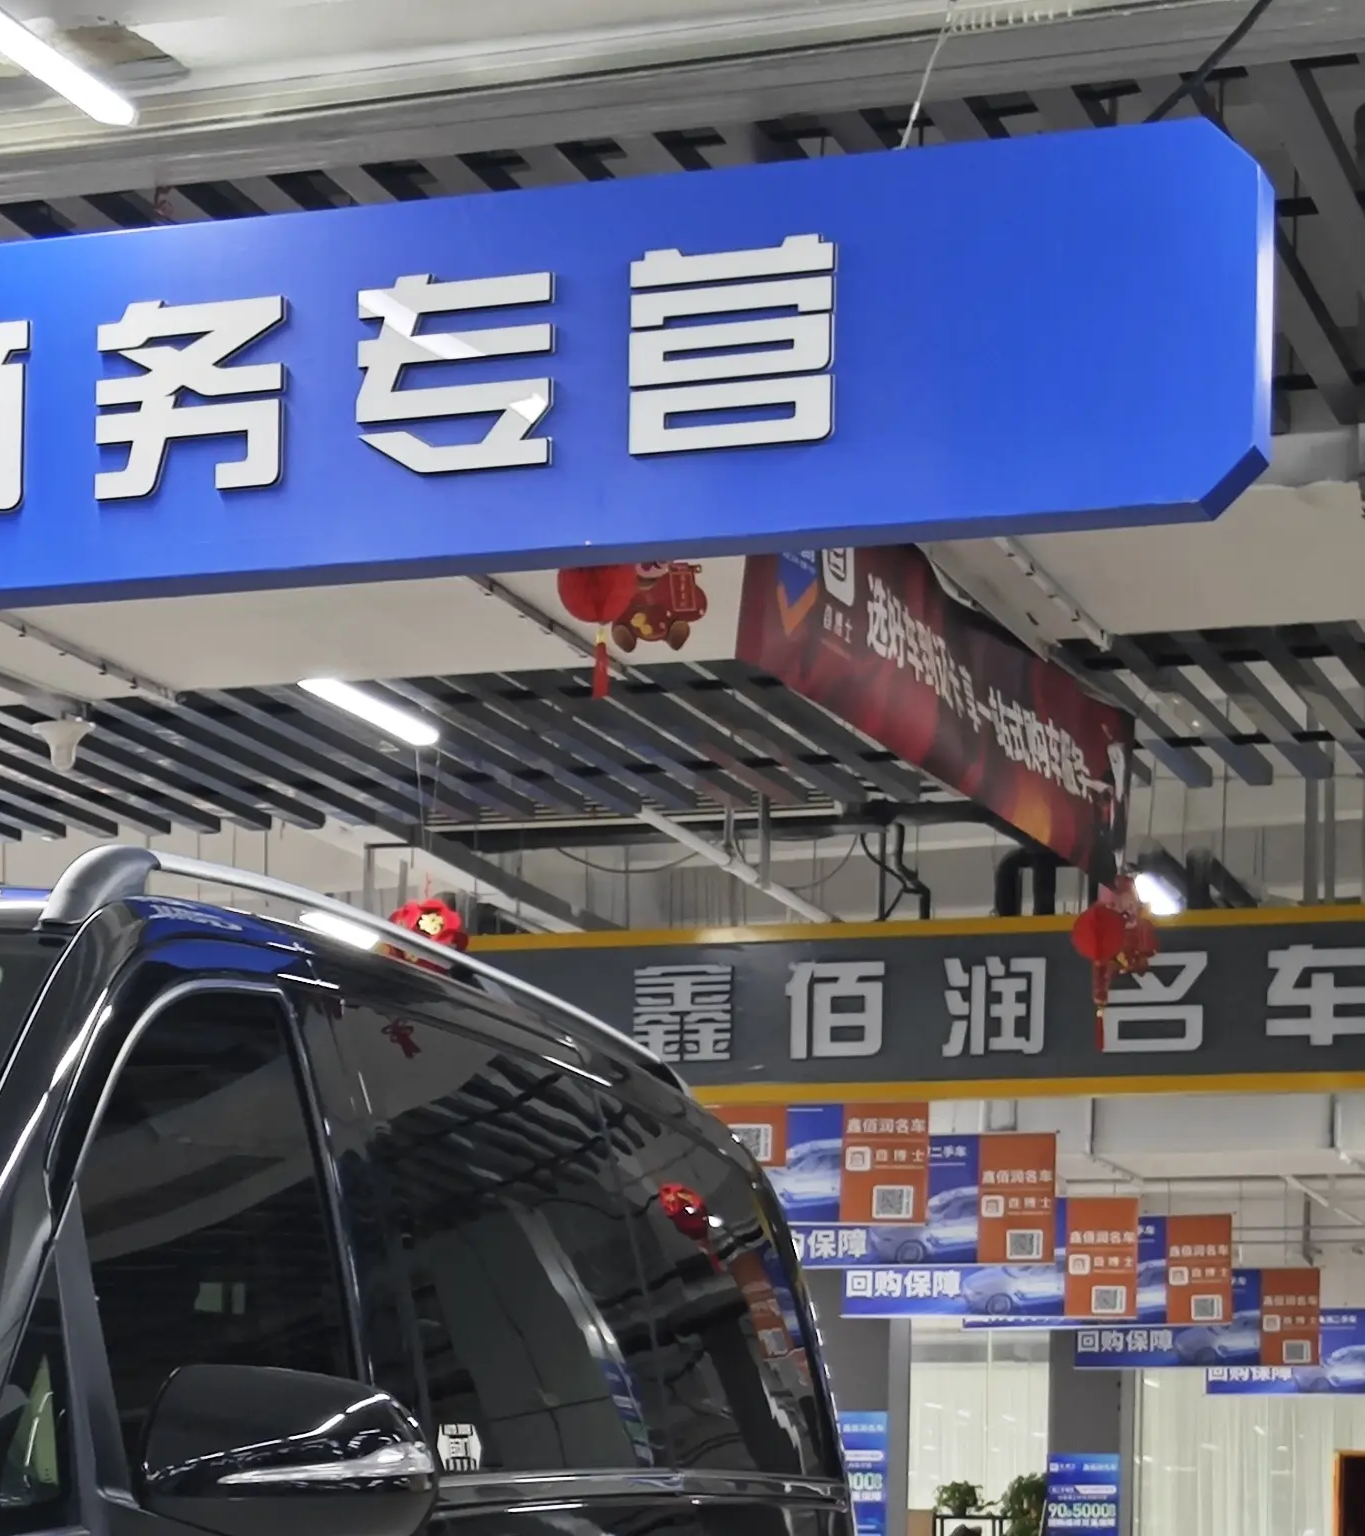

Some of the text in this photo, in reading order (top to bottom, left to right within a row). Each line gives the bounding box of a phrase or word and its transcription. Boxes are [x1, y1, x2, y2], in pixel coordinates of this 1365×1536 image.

[633, 944, 1365, 1062] 鑫佰润名车
[846, 1117, 926, 1135] 鑫佰润名车
[927, 1145, 969, 1160] 二手车
[845, 1269, 962, 1300] 回购保障
[1076, 1329, 1174, 1354] 回购保障
